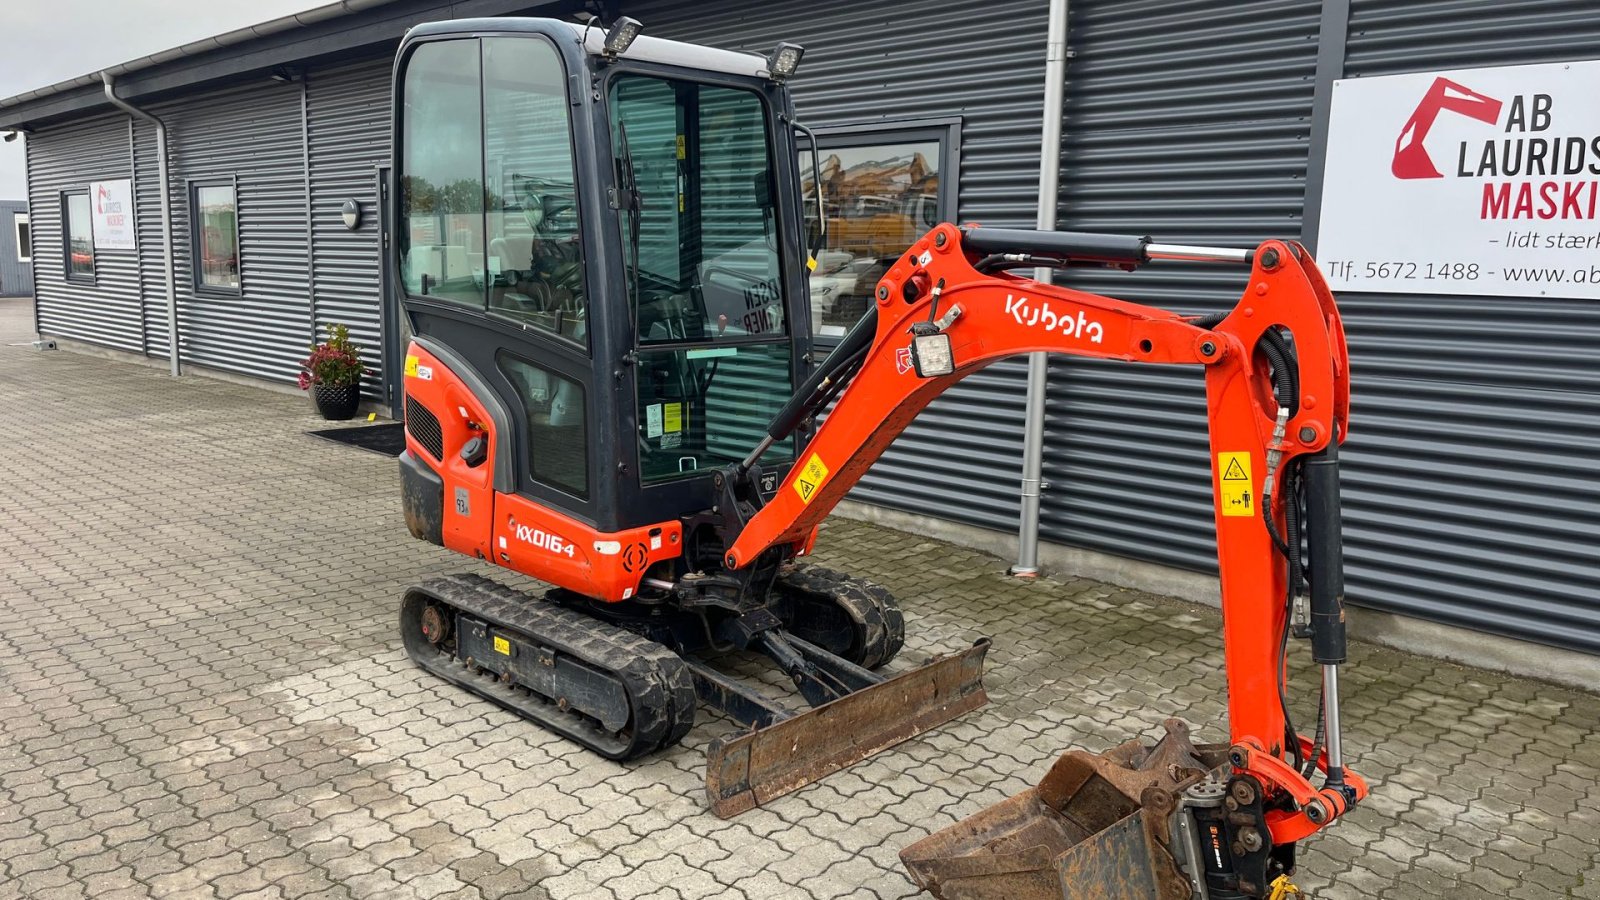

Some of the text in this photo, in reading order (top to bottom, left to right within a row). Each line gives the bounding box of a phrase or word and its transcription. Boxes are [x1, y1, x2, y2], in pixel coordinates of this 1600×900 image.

[1505, 93, 1553, 133] AB
[1457, 135, 1600, 178] LAURIDS
[1480, 181, 1599, 220] MASKI
[1506, 231, 1540, 249] lidt
[1327, 261, 1358, 282] Tlf.
[1365, 262, 1417, 280] 5672
[1423, 263, 1480, 281] 1488
[1005, 294, 1104, 344] Kubota
[516, 524, 575, 558] KX016-4
